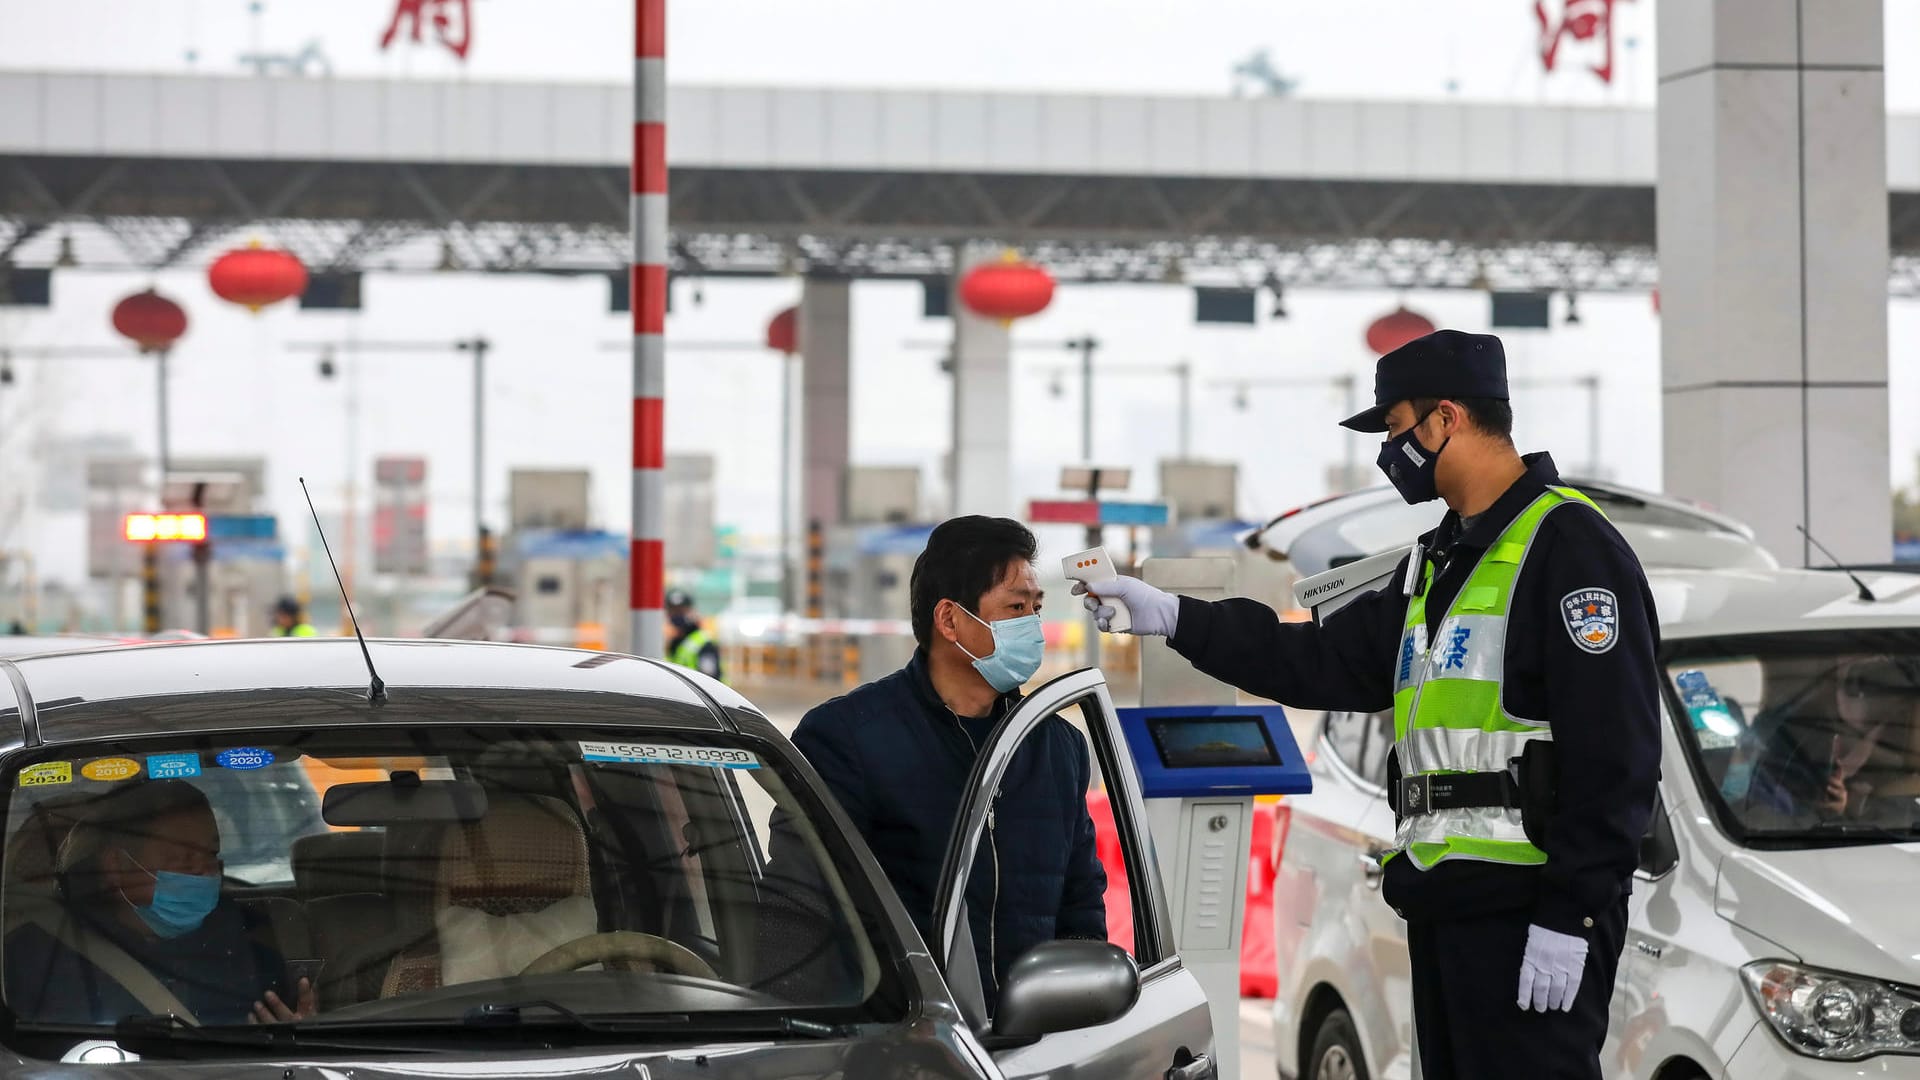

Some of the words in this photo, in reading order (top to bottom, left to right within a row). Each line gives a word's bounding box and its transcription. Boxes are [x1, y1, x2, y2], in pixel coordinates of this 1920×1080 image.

[1303, 577, 1345, 600] HIKVISION
[1565, 592, 1613, 609] 中华人民共和国
[611, 745, 750, 762] 15927210990
[230, 756, 262, 765] 2020
[95, 766, 128, 777] 2019
[155, 767, 196, 778] 2019
[25, 775, 67, 785] 2020
